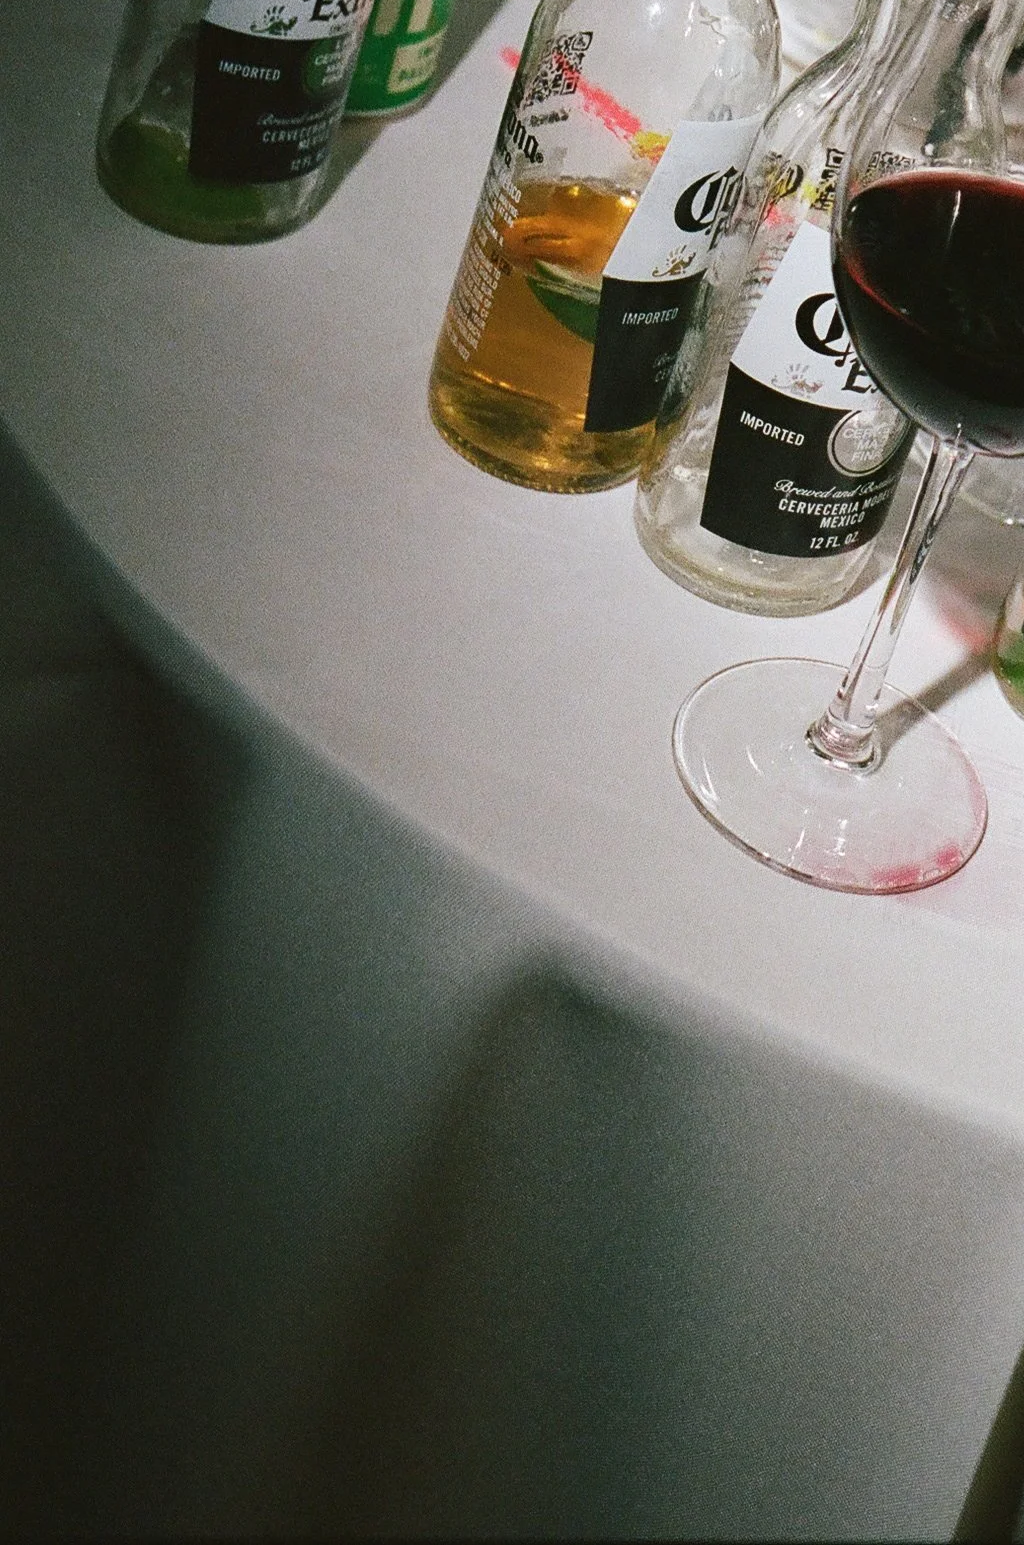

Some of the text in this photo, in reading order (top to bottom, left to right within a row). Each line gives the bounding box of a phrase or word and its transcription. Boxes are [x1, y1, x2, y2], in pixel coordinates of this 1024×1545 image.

[218, 60, 281, 81] IMPORTED
[622, 307, 678, 325] IMPORTED
[740, 410, 805, 447] IMPORTED
[774, 479, 837, 499] Brewed
[833, 485, 862, 499] and
[778, 499, 860, 517] CERVECERIA
[819, 511, 865, 529] MEXICO
[809, 537, 823, 550] 12
